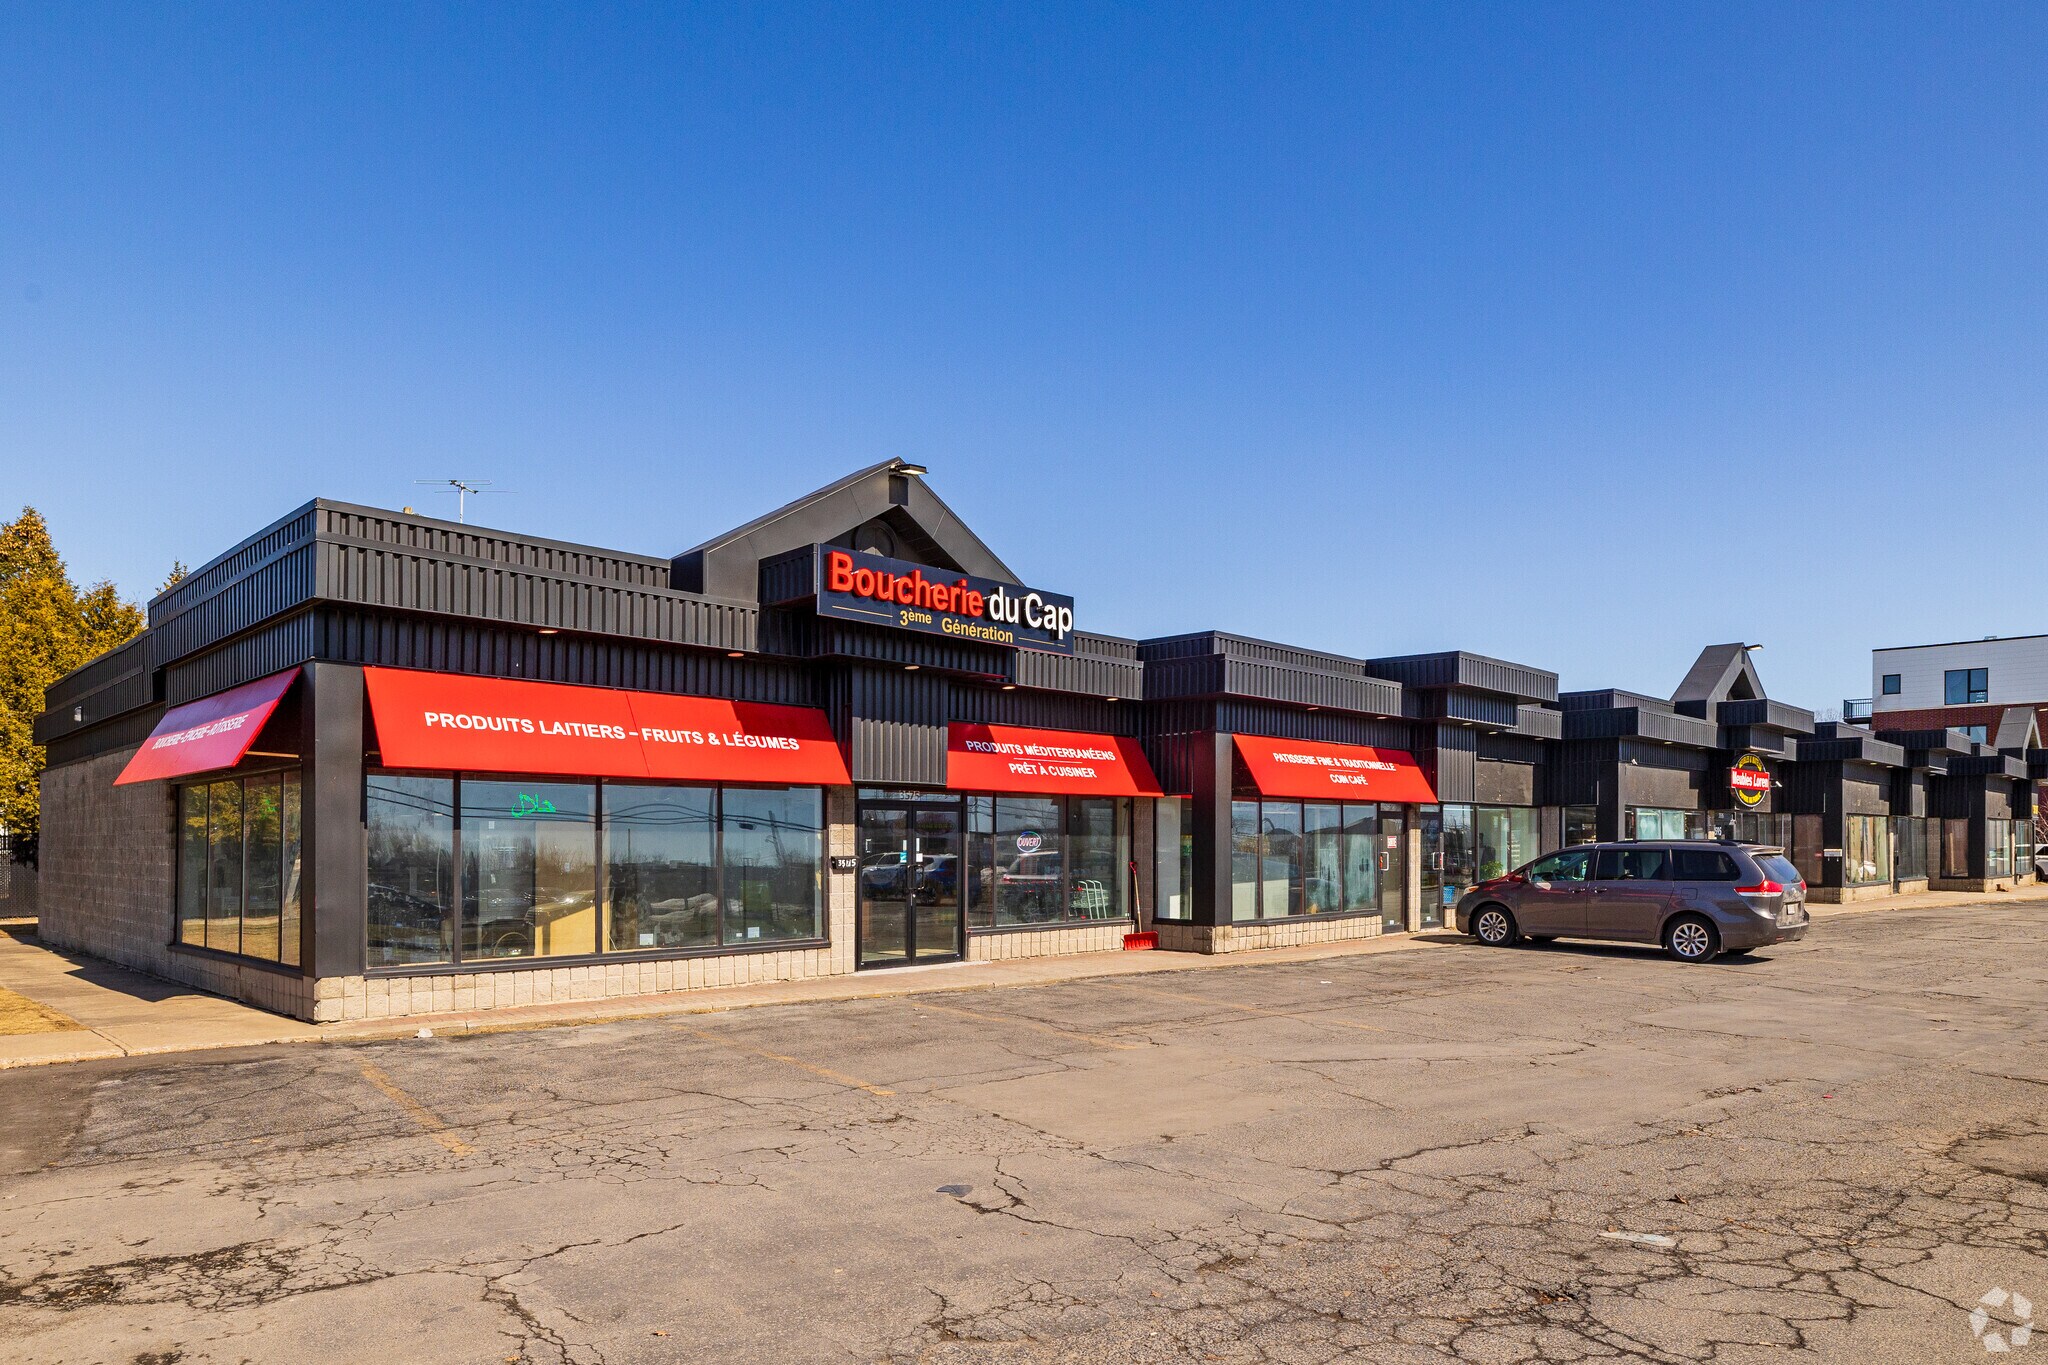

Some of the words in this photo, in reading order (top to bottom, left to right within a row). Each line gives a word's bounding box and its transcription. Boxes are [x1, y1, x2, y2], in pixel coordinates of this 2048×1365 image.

[828, 551, 984, 617] Boucherie
[989, 586, 1019, 624] du
[1025, 592, 1073, 640] Cap
[900, 608, 932, 627] 3ème
[942, 617, 1014, 643] Génération
[424, 711, 535, 734] PRODUITS
[538, 720, 626, 740] LAITIERS
[641, 727, 704, 745] FRUITS
[707, 731, 721, 746] &
[722, 730, 800, 751] LÉGUMES
[965, 740, 1023, 755] PRODUITS
[1023, 743, 1116, 761] MÉDITERRANÉENS
[1008, 761, 1037, 775] PRÊT
[1038, 762, 1049, 776] À
[1048, 765, 1098, 778] CUISINER
[1316, 756, 1335, 767] FINE
[1329, 773, 1350, 785] COIN
[1348, 774, 1369, 785] CAFÉ
[511, 791, 557, 819] حلال
[1019, 837, 1040, 847] OUVERT
